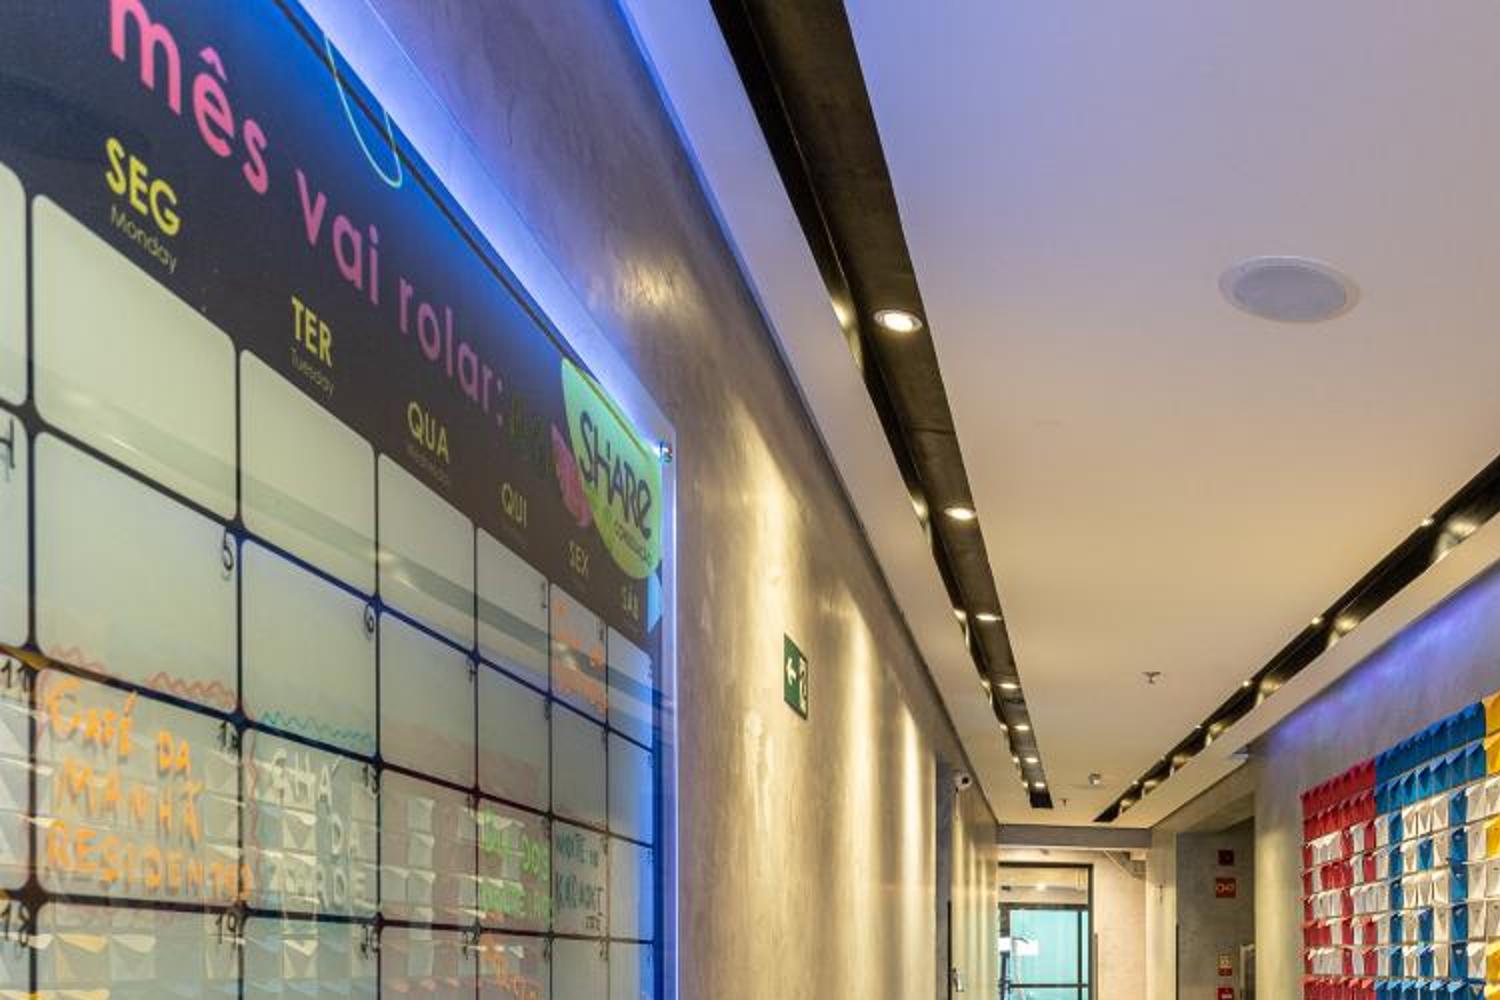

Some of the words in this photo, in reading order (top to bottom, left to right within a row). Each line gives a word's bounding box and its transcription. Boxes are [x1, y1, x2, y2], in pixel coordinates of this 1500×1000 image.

[105, 136, 181, 236] SEG
[109, 0, 268, 194] mês
[297, 168, 379, 305] vai
[399, 276, 503, 427] rolar:
[110, 204, 177, 274] Monday
[292, 295, 332, 368] TER
[407, 401, 449, 464] QUA
[501, 482, 527, 528] QUI
